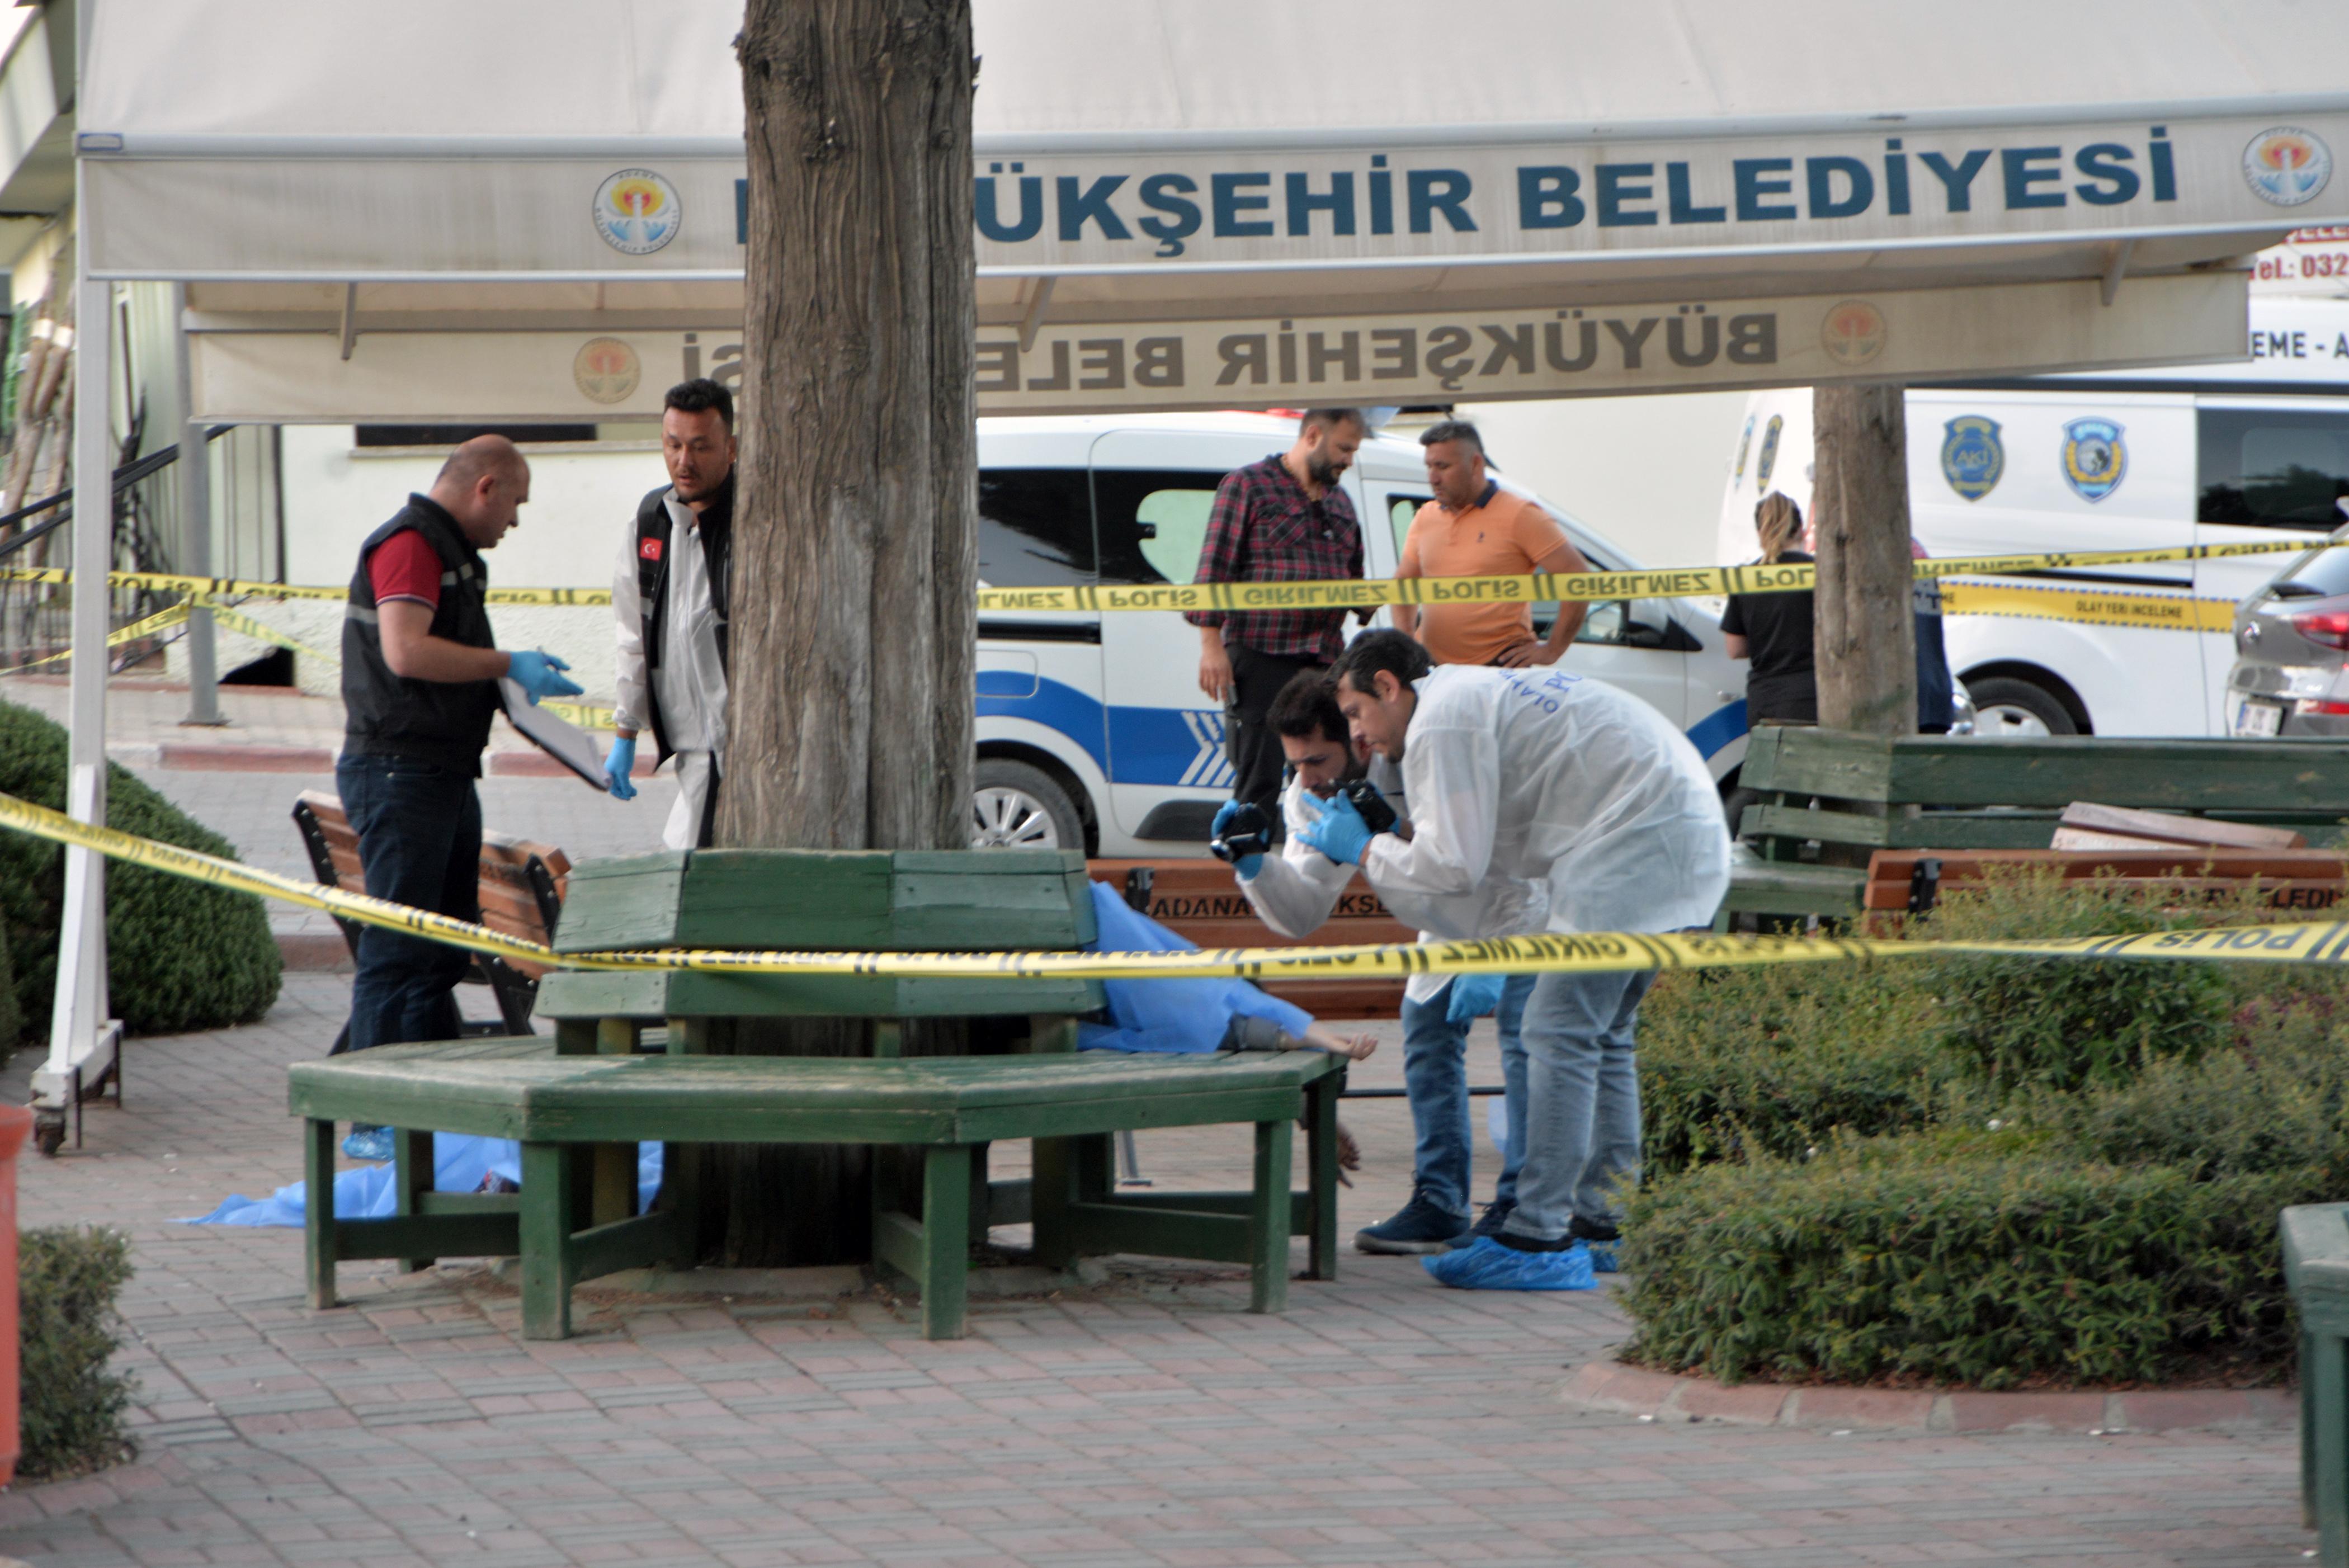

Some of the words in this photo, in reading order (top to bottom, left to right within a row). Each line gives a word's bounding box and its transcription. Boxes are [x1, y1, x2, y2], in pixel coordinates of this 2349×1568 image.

[737, 155, 1478, 256] ÜKŞEHİR
[1518, 126, 2177, 229] BELEDİYESİ
[2248, 256, 2295, 281] el.:
[2075, 599, 2103, 613] OLAY
[1154, 897, 1252, 918] ADANA
